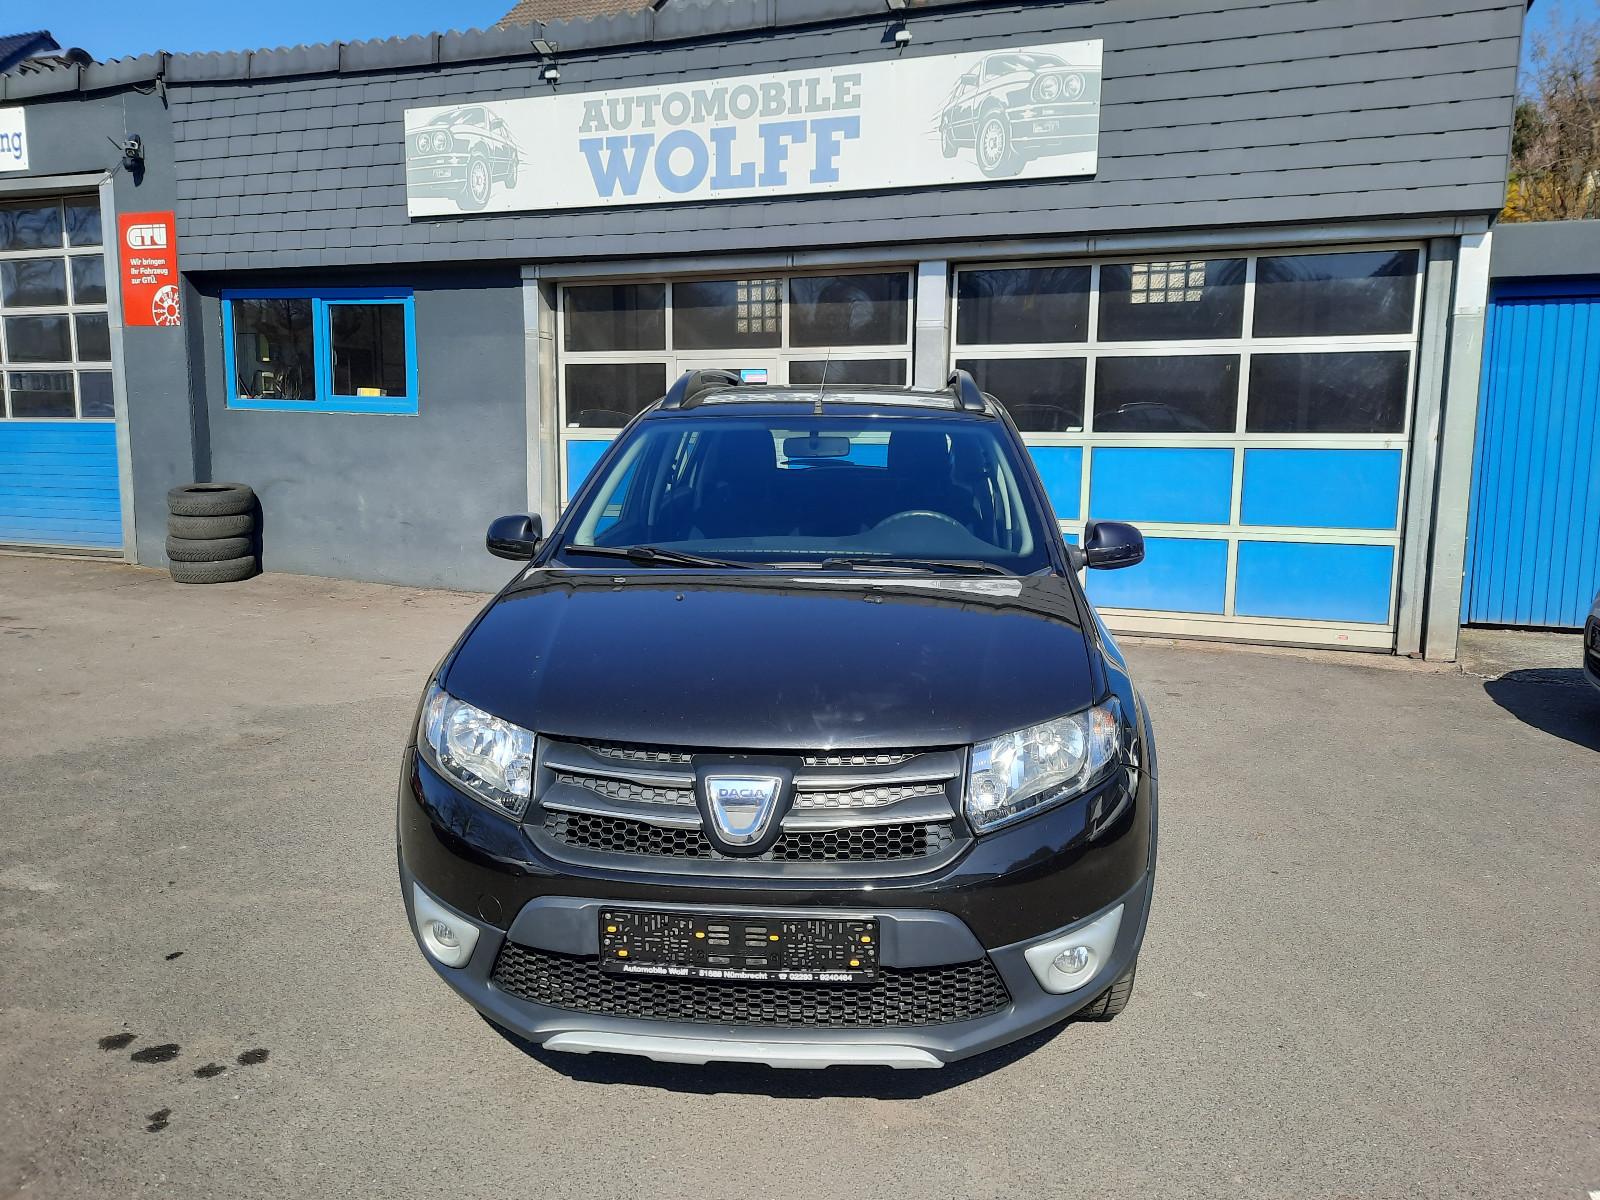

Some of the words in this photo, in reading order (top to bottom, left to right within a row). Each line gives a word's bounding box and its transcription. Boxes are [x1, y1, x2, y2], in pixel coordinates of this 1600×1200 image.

[579, 73, 862, 133] AUTOMOBILE
[579, 115, 861, 198] WOLFF
[142, 258, 166, 267] bringen
[140, 267, 169, 276] Fahrzeug
[719, 788, 765, 797] DACIA
[623, 965, 667, 974] Automobile
